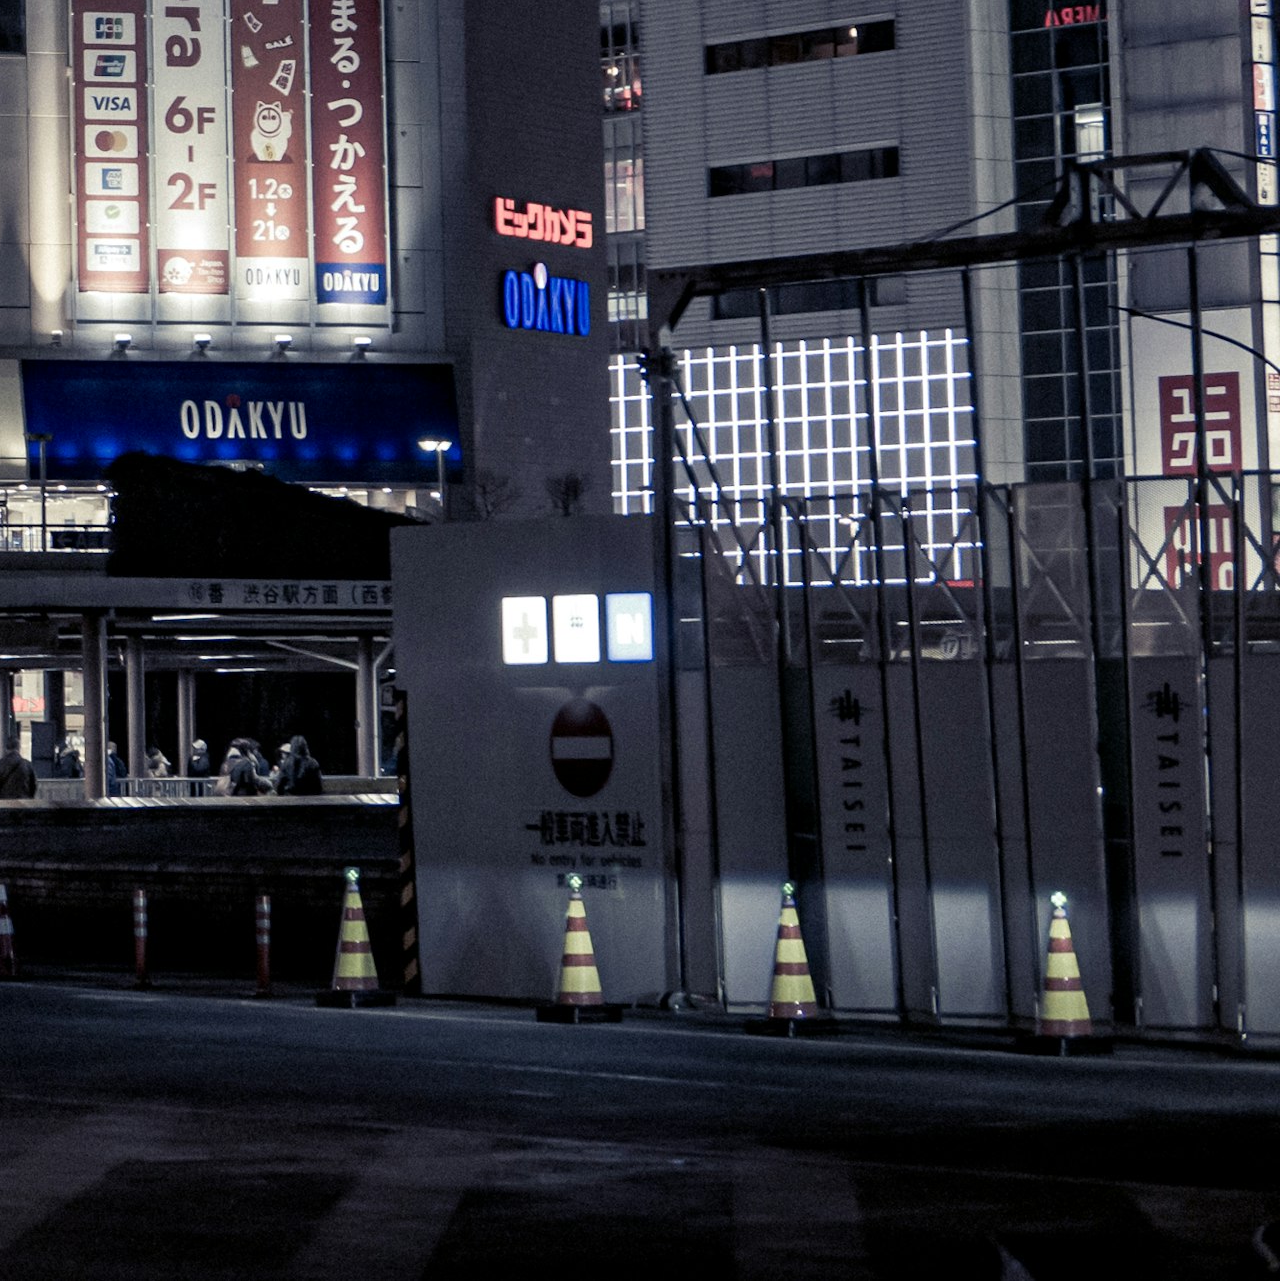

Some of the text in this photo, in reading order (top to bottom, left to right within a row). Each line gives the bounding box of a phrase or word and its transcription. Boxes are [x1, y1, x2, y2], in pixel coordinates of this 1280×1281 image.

[265, 34, 294, 50] SALE
[91, 96, 131, 111] VISA
[165, 96, 215, 134] 6F
[167, 172, 217, 210] 2F
[495, 197, 593, 249] ビックカメラ
[246, 268, 300, 286] ODAKYU
[323, 271, 380, 292] ODAKYU
[504, 264, 590, 337] ODAKYU
[180, 397, 308, 440] ODAKYU
[840, 735, 866, 851] TAISEI
[1157, 733, 1183, 857] TAISEI
[526, 810, 647, 847] 一般車両進入禁止
[531, 854, 545, 866] No
[550, 855, 576, 870] entry
